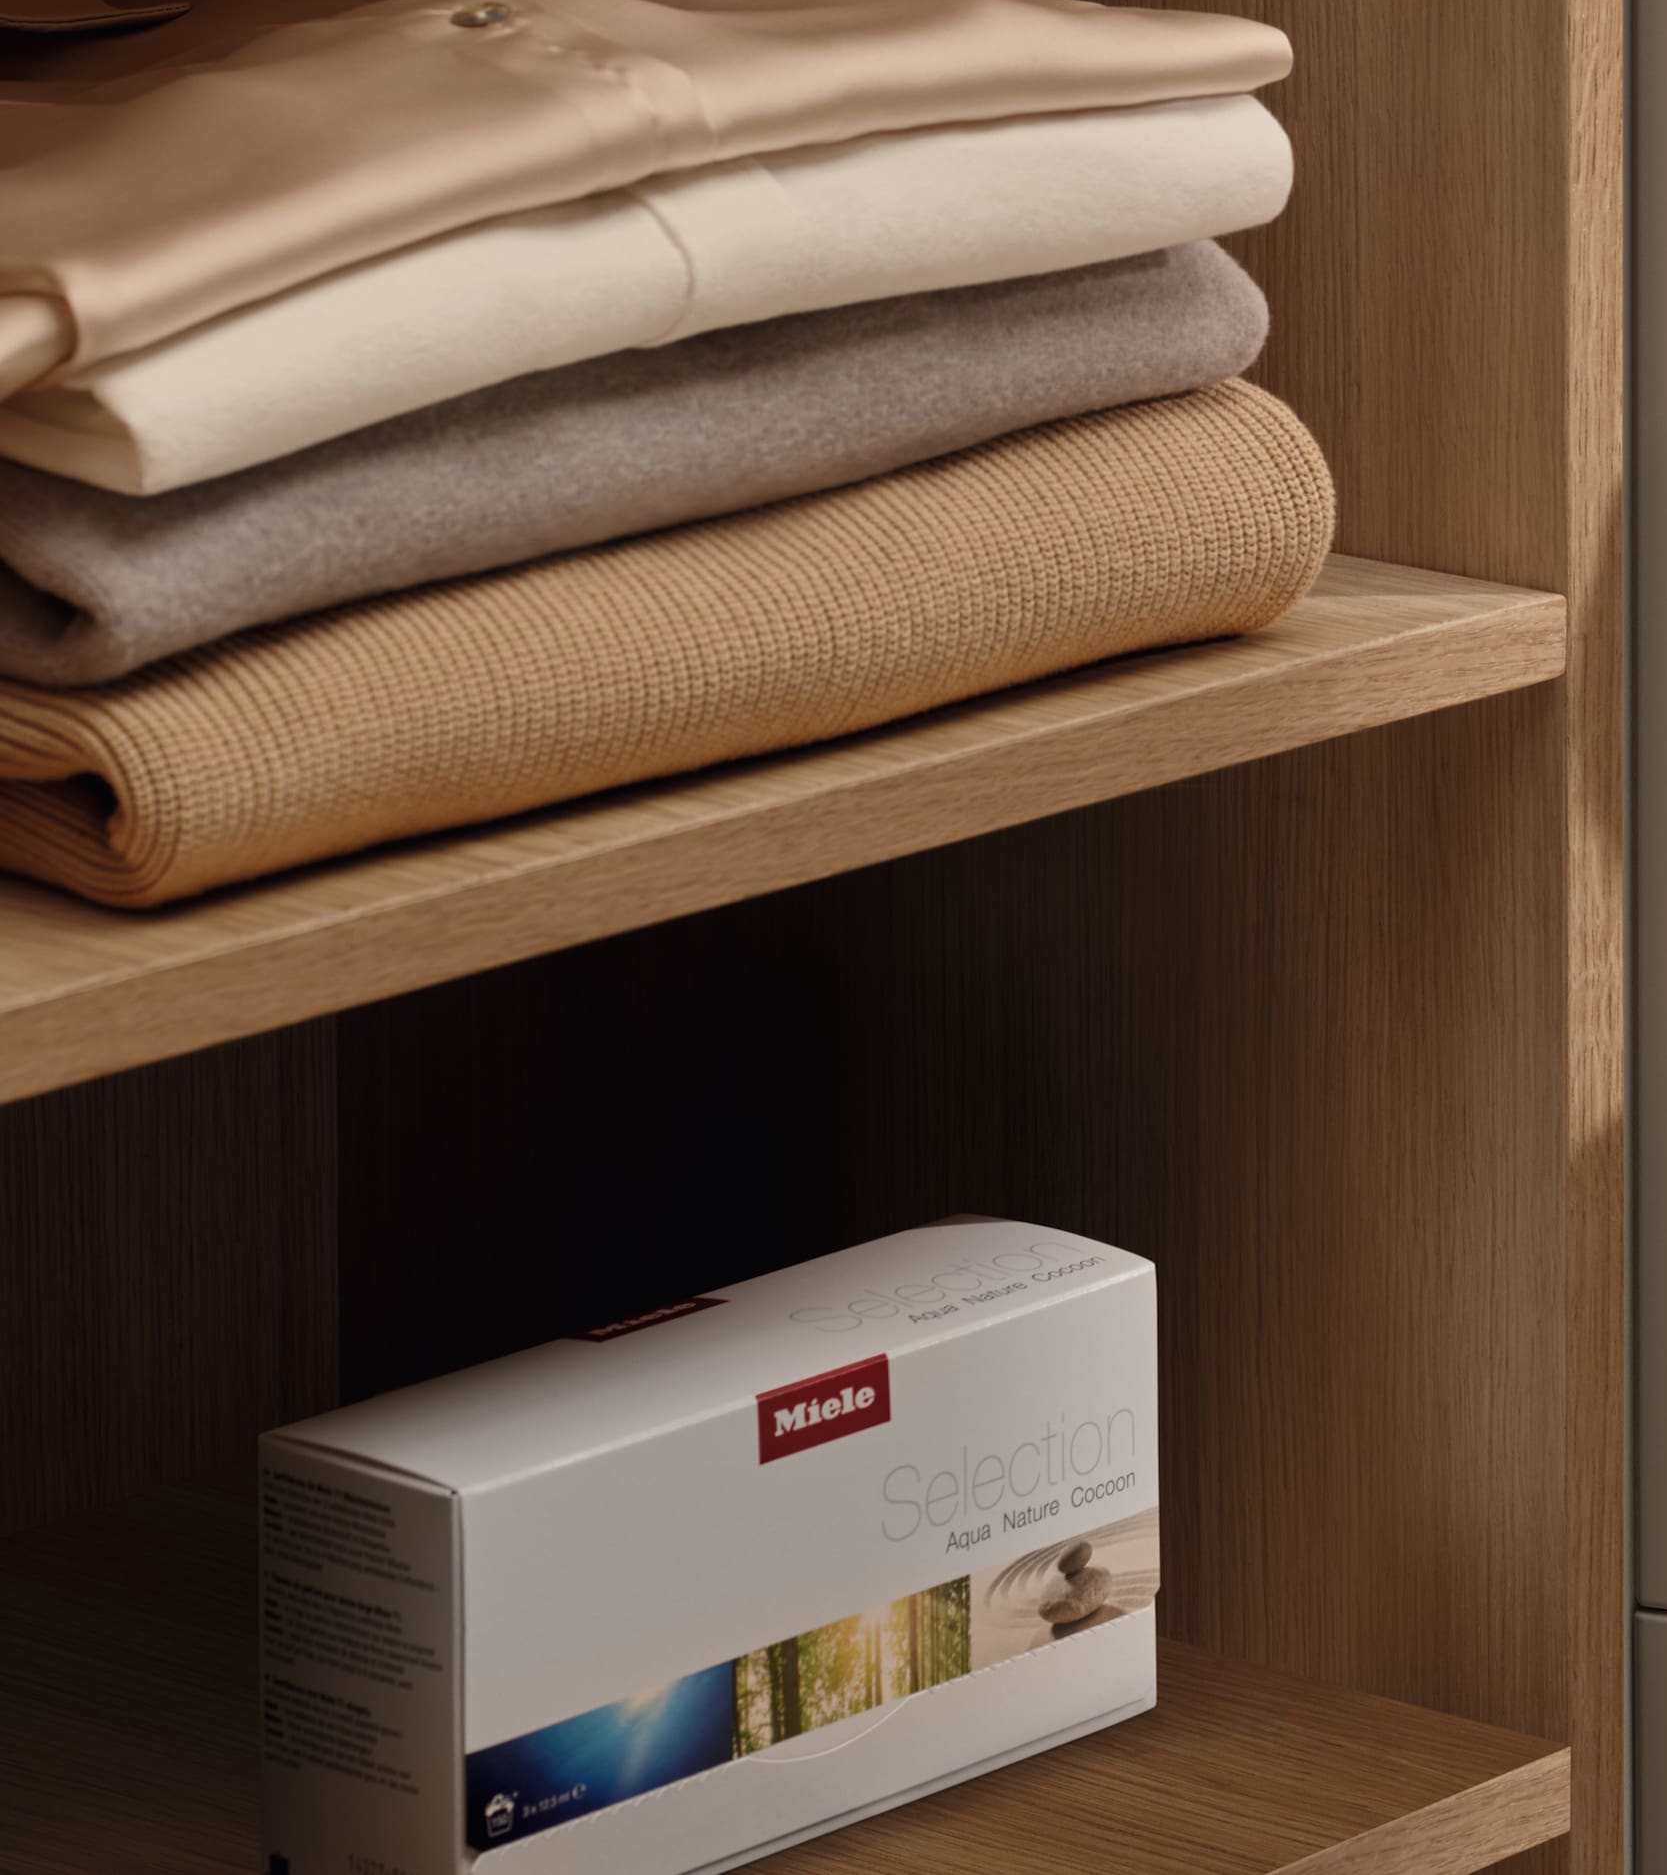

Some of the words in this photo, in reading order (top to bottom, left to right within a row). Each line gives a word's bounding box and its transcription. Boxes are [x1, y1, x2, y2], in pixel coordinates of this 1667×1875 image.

[788, 1240, 1084, 1333] Selection
[960, 1282, 1028, 1306] Nature
[1031, 1255, 1106, 1283] Cocoon
[773, 1386, 876, 1437] Miele
[881, 1408, 1136, 1542] Selection
[945, 1524, 991, 1554] Aqua
[1003, 1500, 1060, 1533] Nature
[1070, 1471, 1136, 1508] Cocoon
